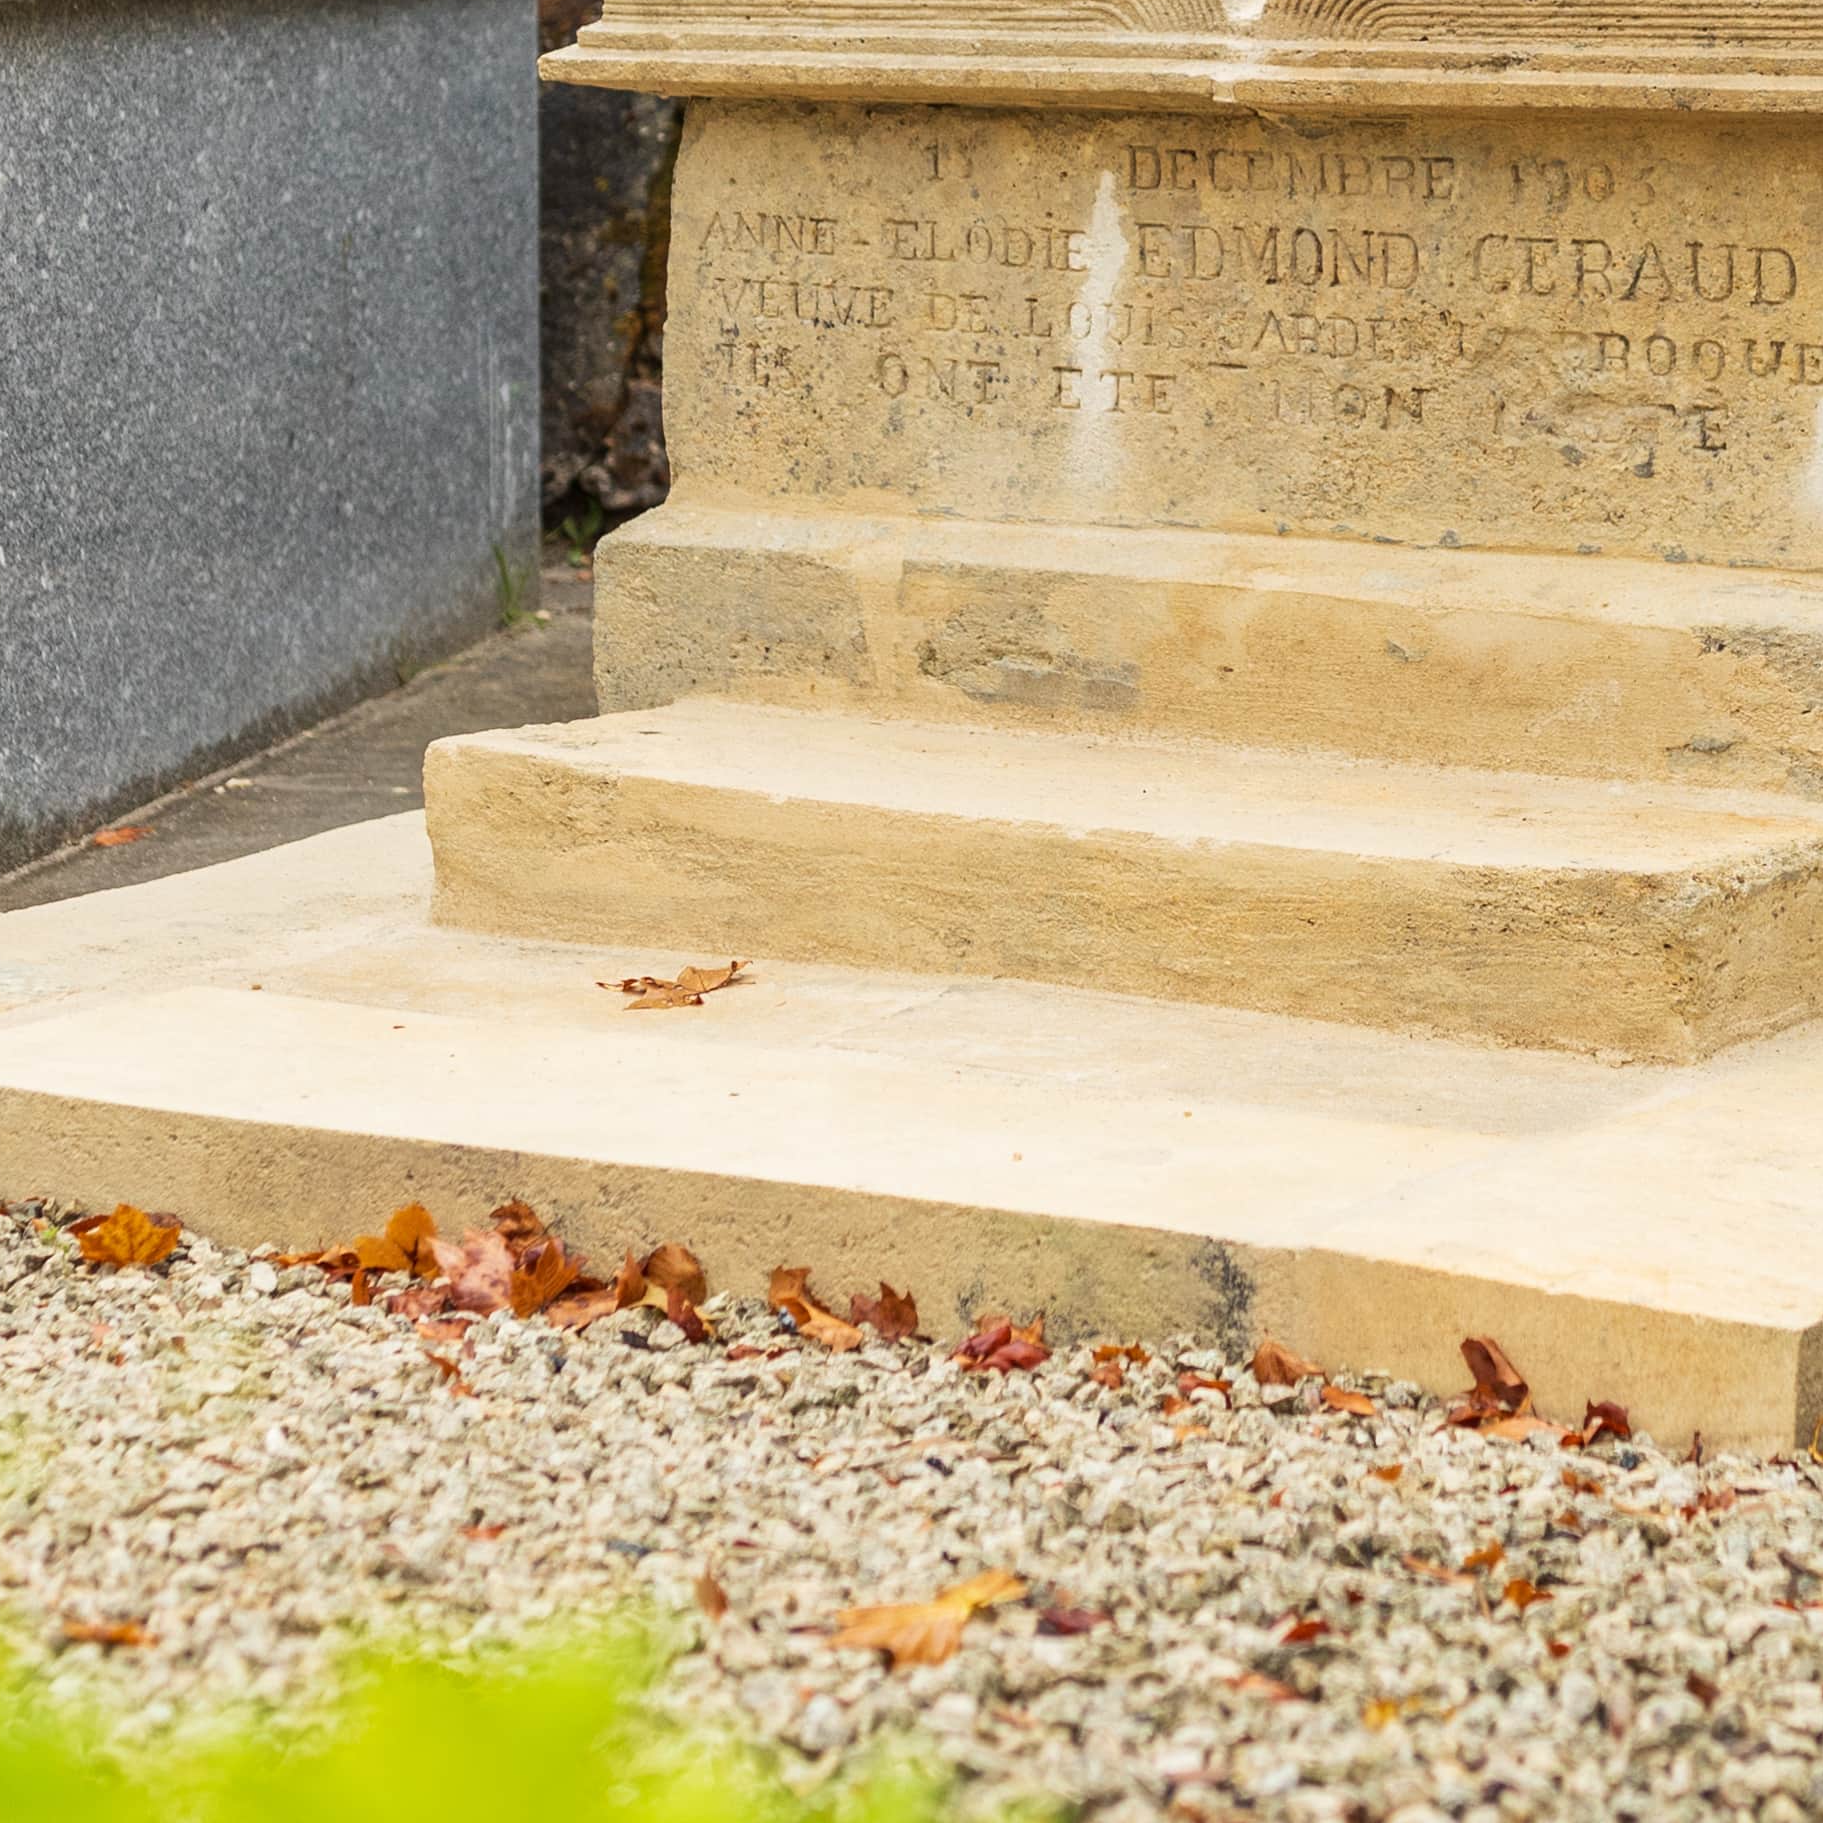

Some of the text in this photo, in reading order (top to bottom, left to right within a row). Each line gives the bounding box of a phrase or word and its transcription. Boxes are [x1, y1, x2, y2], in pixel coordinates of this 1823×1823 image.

[1126, 143, 1455, 199] DECEMBRE
[1134, 222, 1419, 288] EDMOND
[713, 277, 895, 328] VEUVE
[924, 291, 989, 333] DE
[877, 352, 1000, 406] ONT
